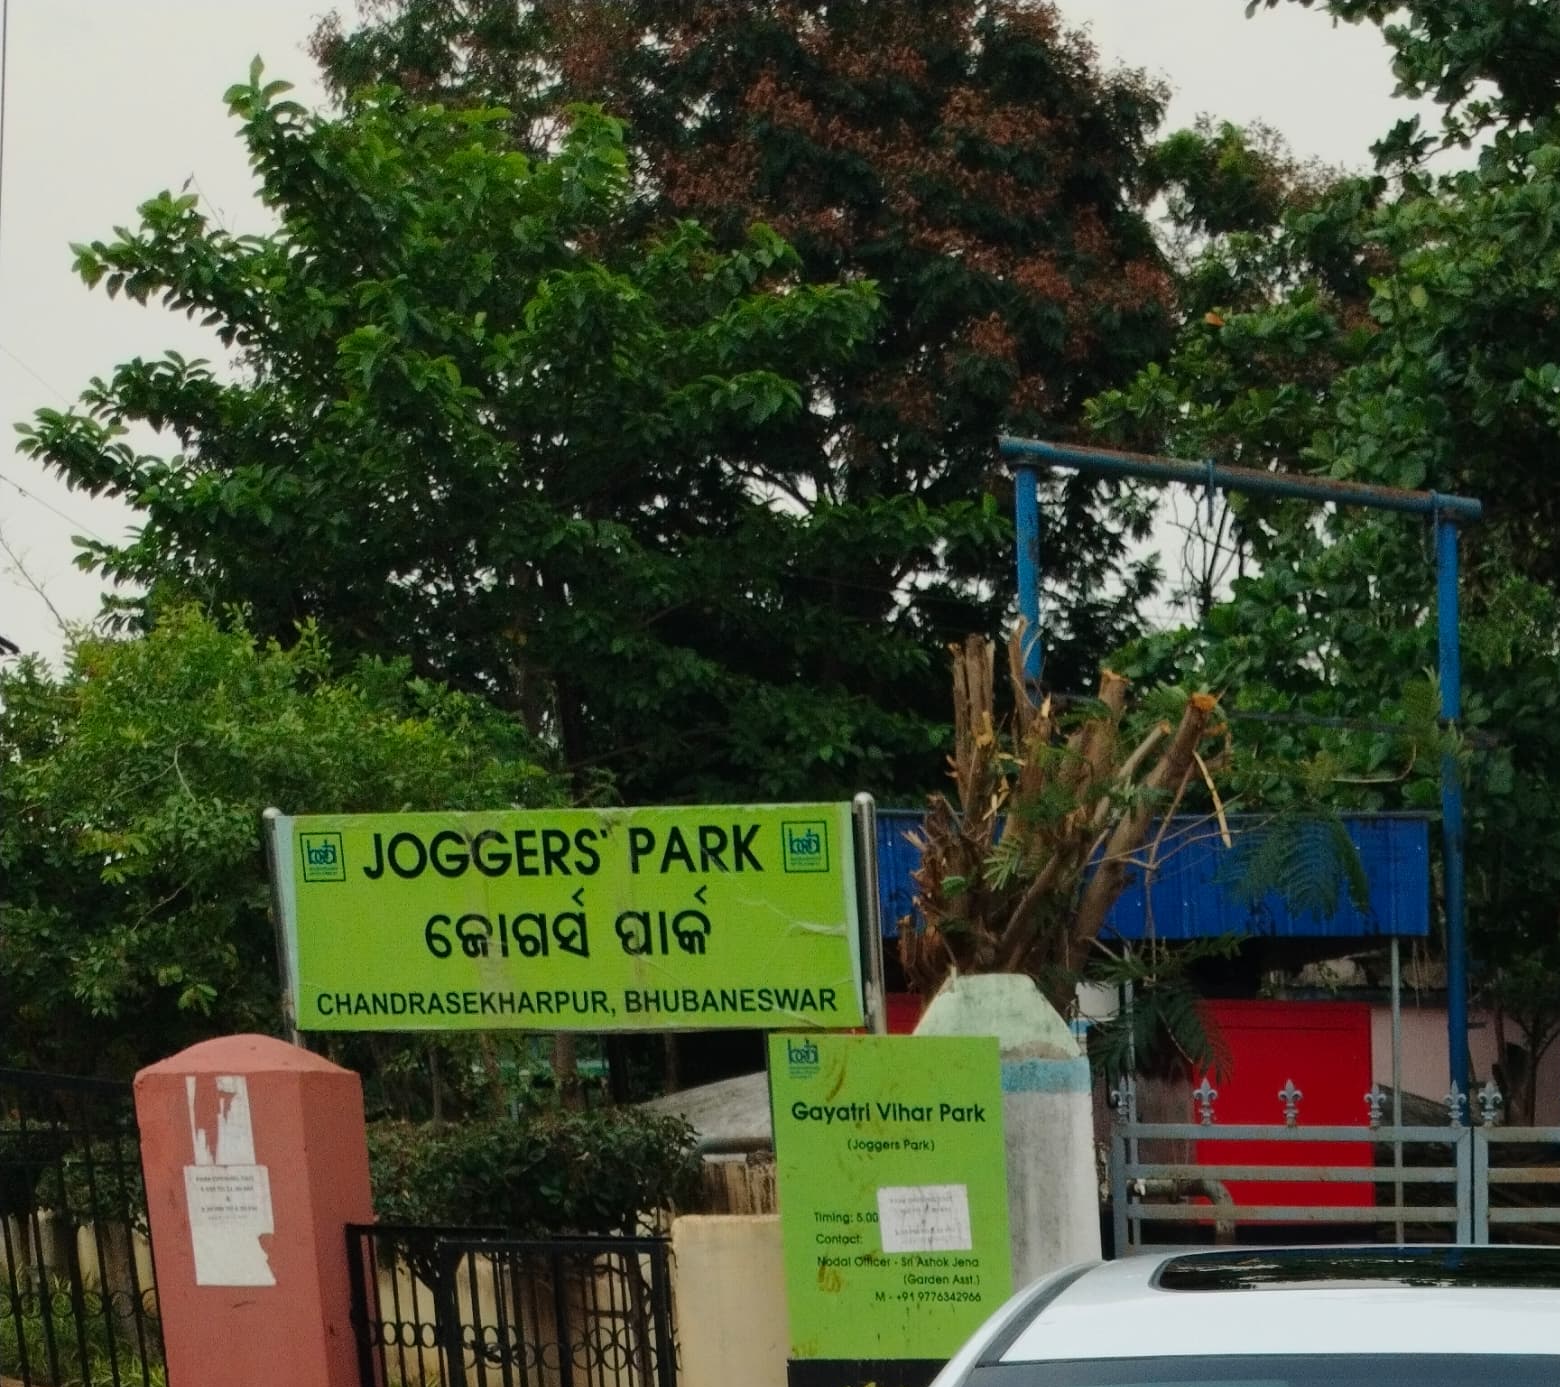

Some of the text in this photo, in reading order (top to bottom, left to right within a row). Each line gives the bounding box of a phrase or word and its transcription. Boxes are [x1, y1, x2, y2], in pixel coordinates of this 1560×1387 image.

[629, 824, 764, 875] PARK
[317, 988, 837, 1017] CHANDRASEKHARPUR, BHUBANESWAR
[791, 1101, 986, 1125] Gayatri Vihar Park
[847, 1139, 935, 1152] (Joggers Park)
[814, 1212, 854, 1225] Timing:
[815, 1233, 863, 1245] Contact:
[817, 1256, 851, 1267] Nodal
[854, 1256, 891, 1267] Officer
[917, 1256, 948, 1267] Ashok
[952, 1256, 979, 1267] Jena
[903, 1274, 949, 1286] (Garden
